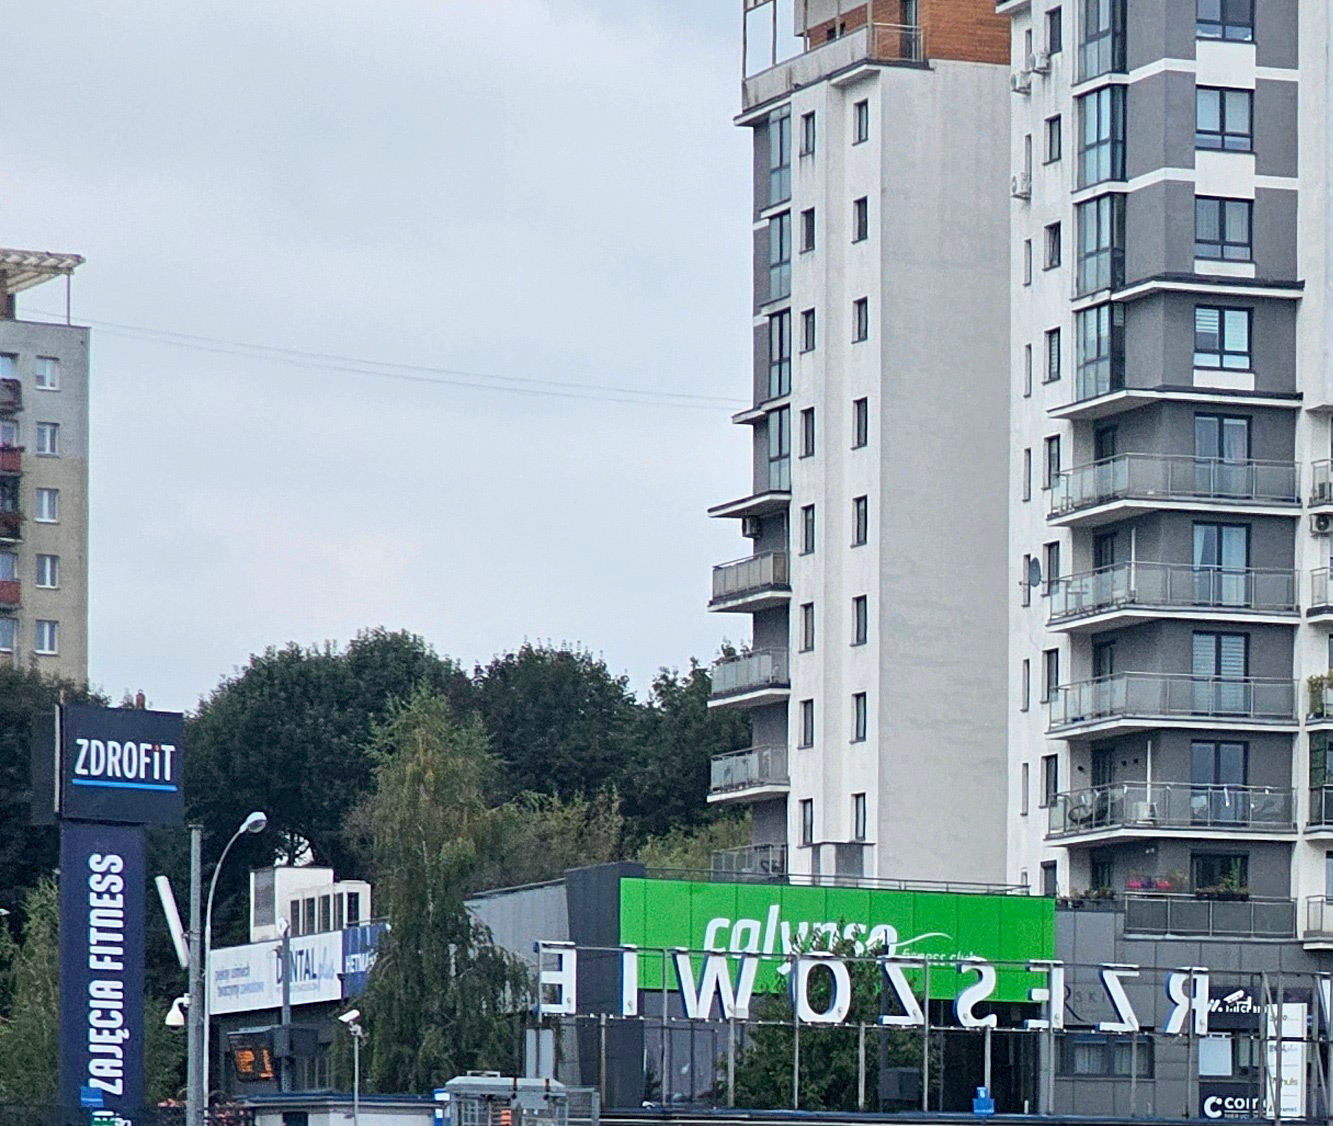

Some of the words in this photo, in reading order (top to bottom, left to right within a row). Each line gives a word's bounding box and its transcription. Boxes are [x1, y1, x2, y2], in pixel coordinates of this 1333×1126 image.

[88, 854, 124, 971] FITNESS
[274, 947, 318, 984] DNTAL
[88, 979, 130, 1096] ZAJĘCIA
